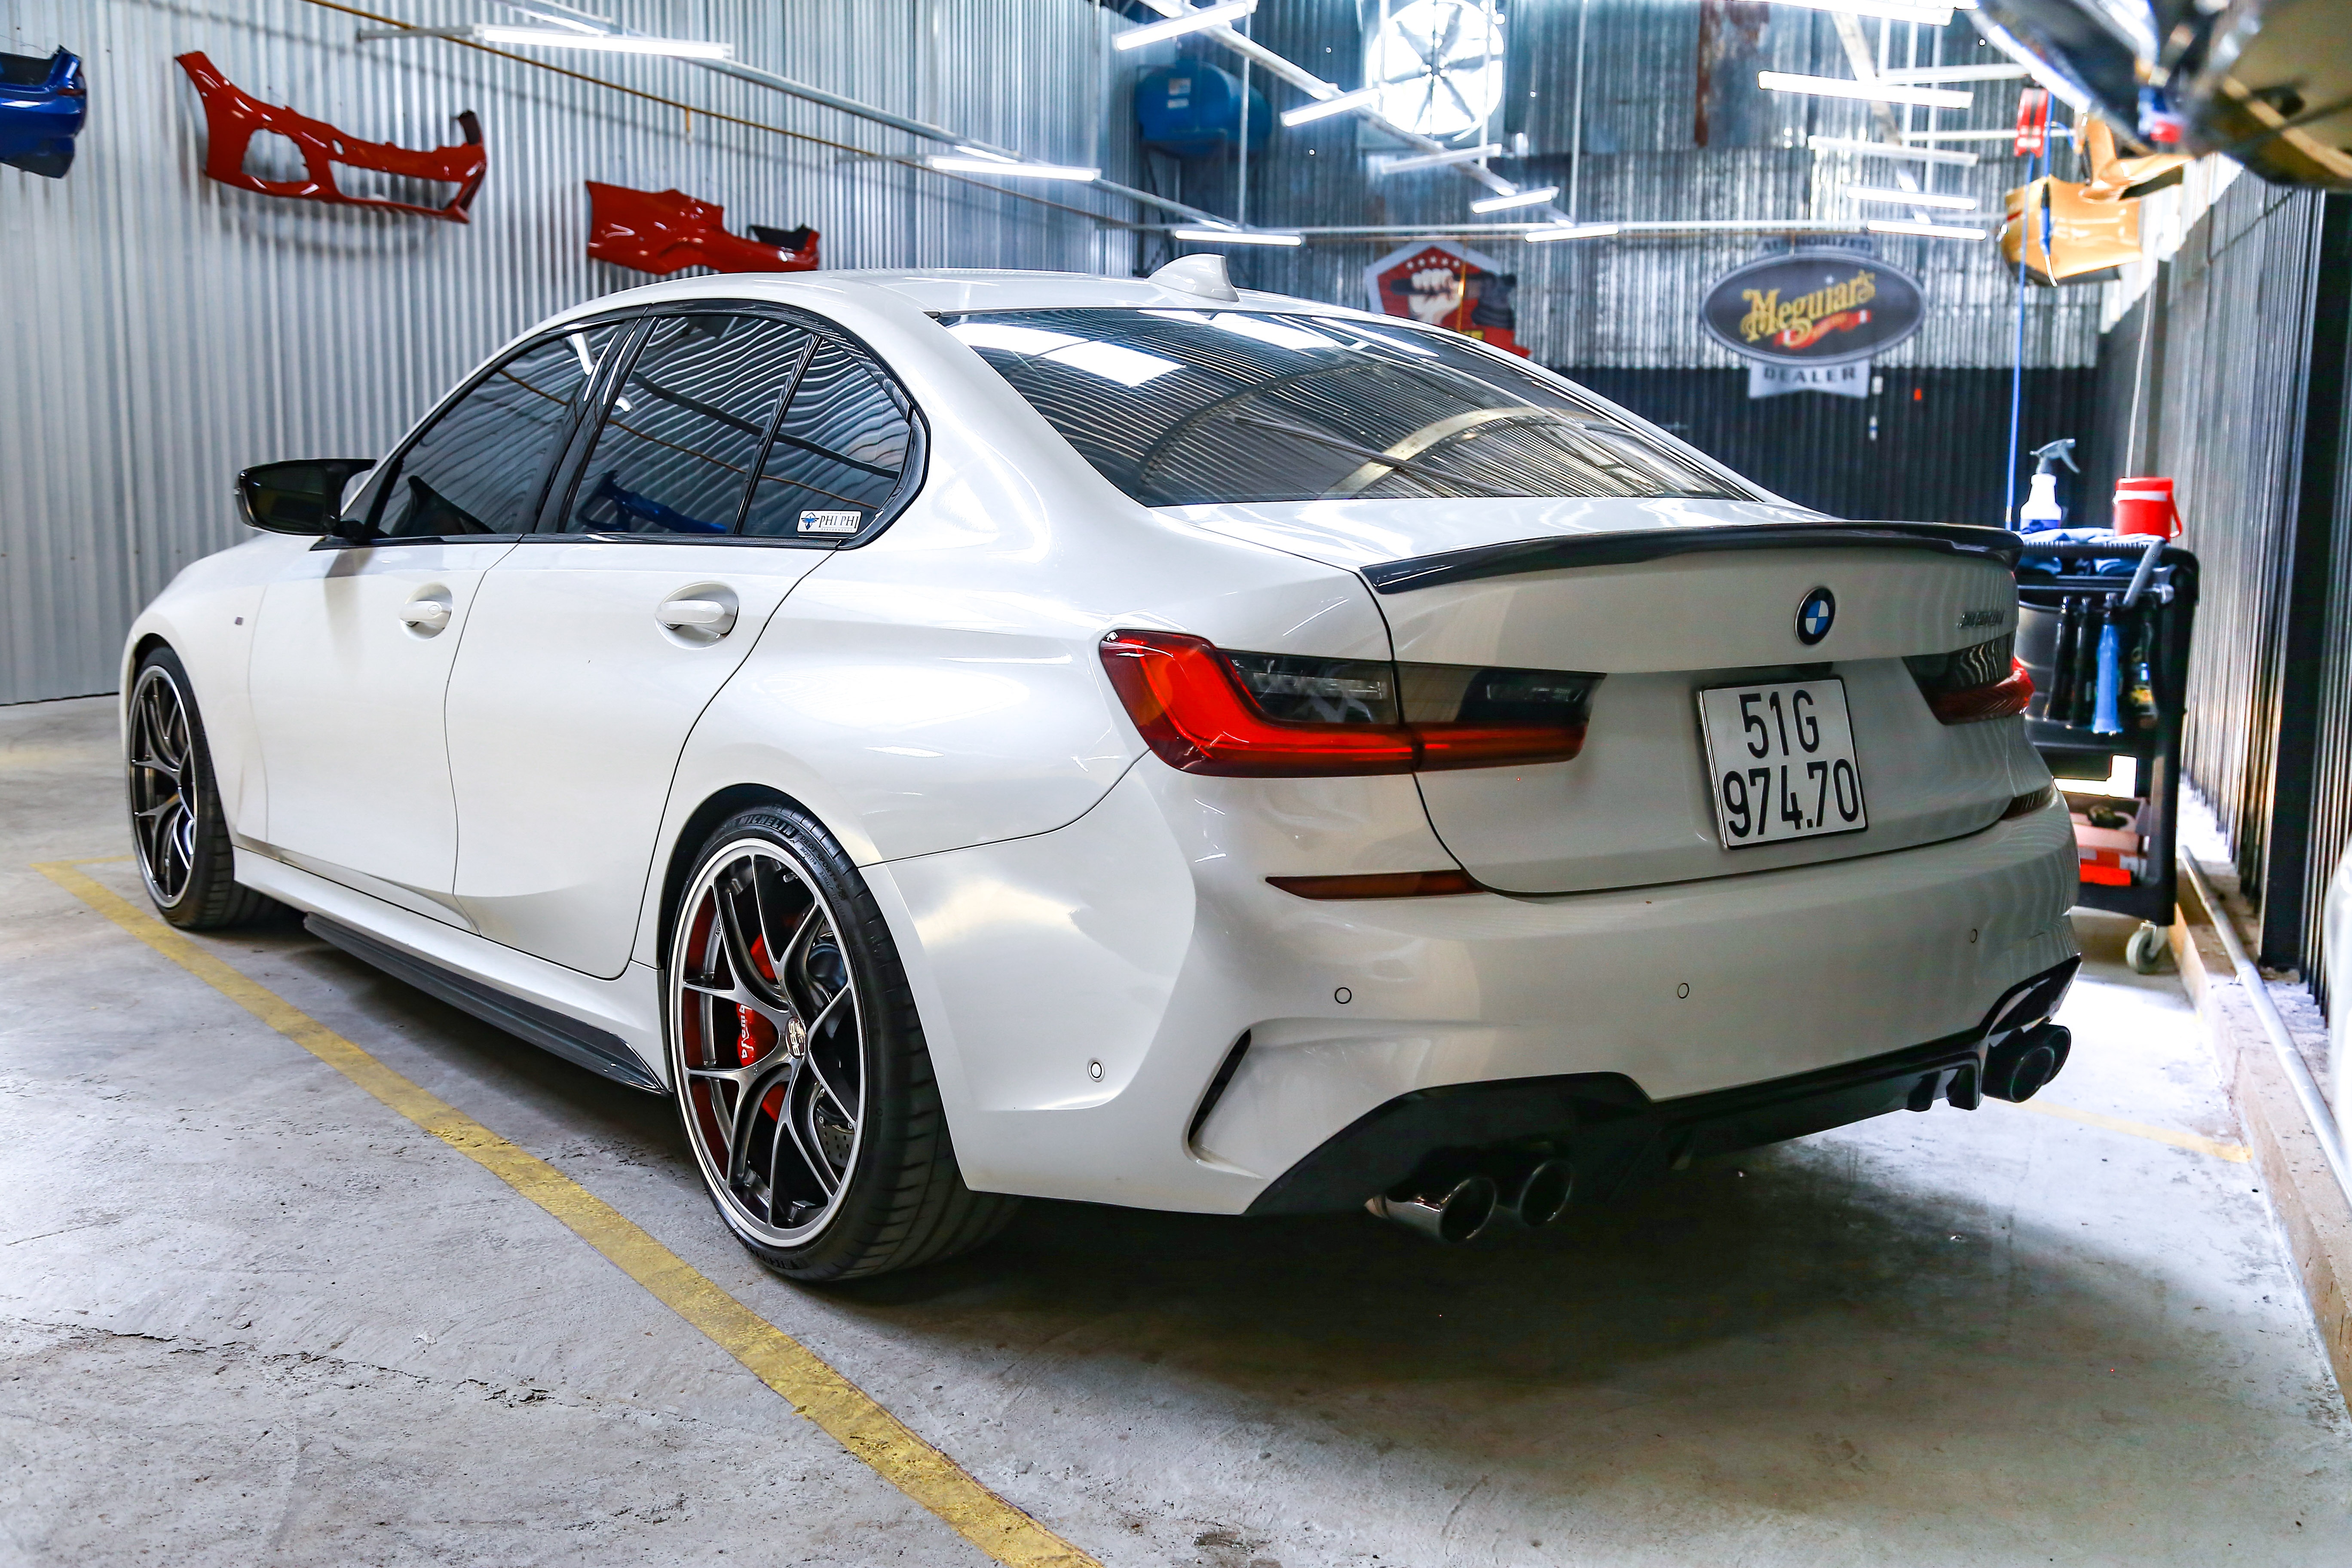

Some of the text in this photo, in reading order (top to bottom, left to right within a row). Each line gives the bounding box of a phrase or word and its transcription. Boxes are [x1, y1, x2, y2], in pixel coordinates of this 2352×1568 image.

[1740, 269, 1876, 346] Meguiar's
[1764, 366, 1856, 383] DEALER
[818, 515, 859, 528] PHI PHI
[1739, 689, 1820, 759] 51G
[1723, 759, 1859, 838] 974.70
[738, 815, 795, 836] MICHELIN
[800, 836, 818, 853] PILOT
[816, 853, 836, 877] SPORT
[739, 1004, 749, 1059] bremb
[788, 1020, 801, 1056] BBS
